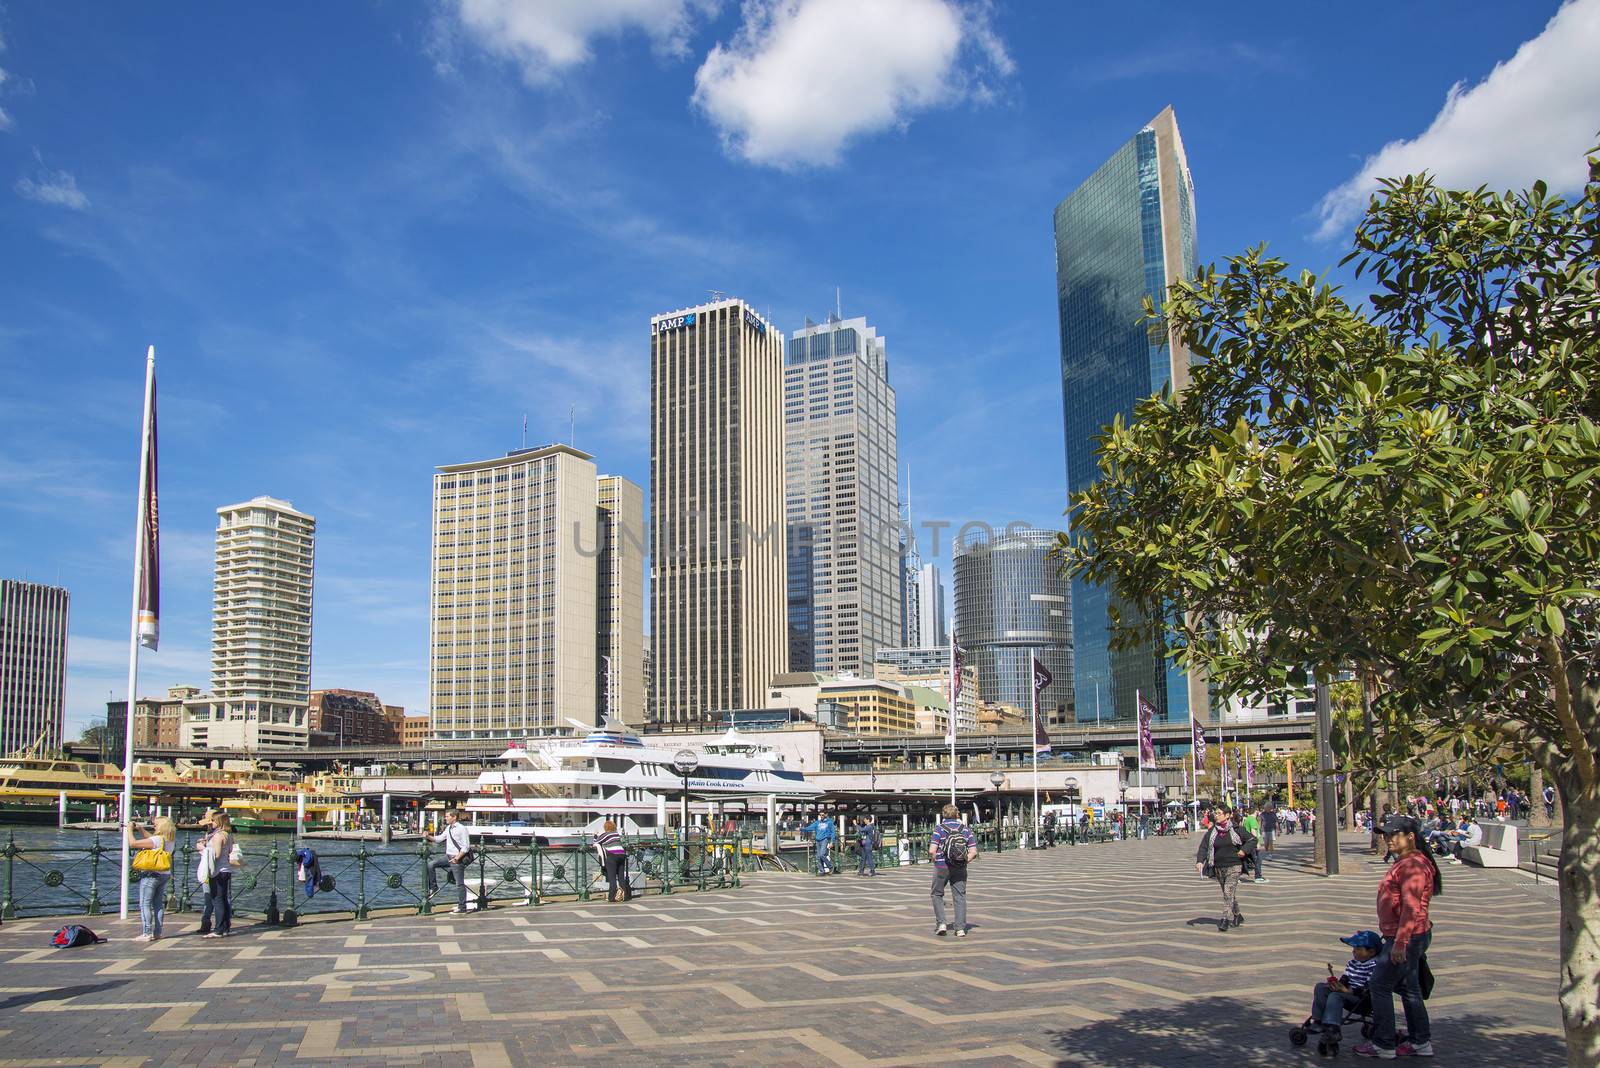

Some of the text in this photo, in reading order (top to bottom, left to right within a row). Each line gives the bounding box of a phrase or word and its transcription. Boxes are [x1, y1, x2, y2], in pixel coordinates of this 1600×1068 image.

[660, 316, 685, 331] AMP
[745, 311, 760, 329] AMP
[680, 779, 706, 788] Cptain
[706, 780, 722, 788] Cook
